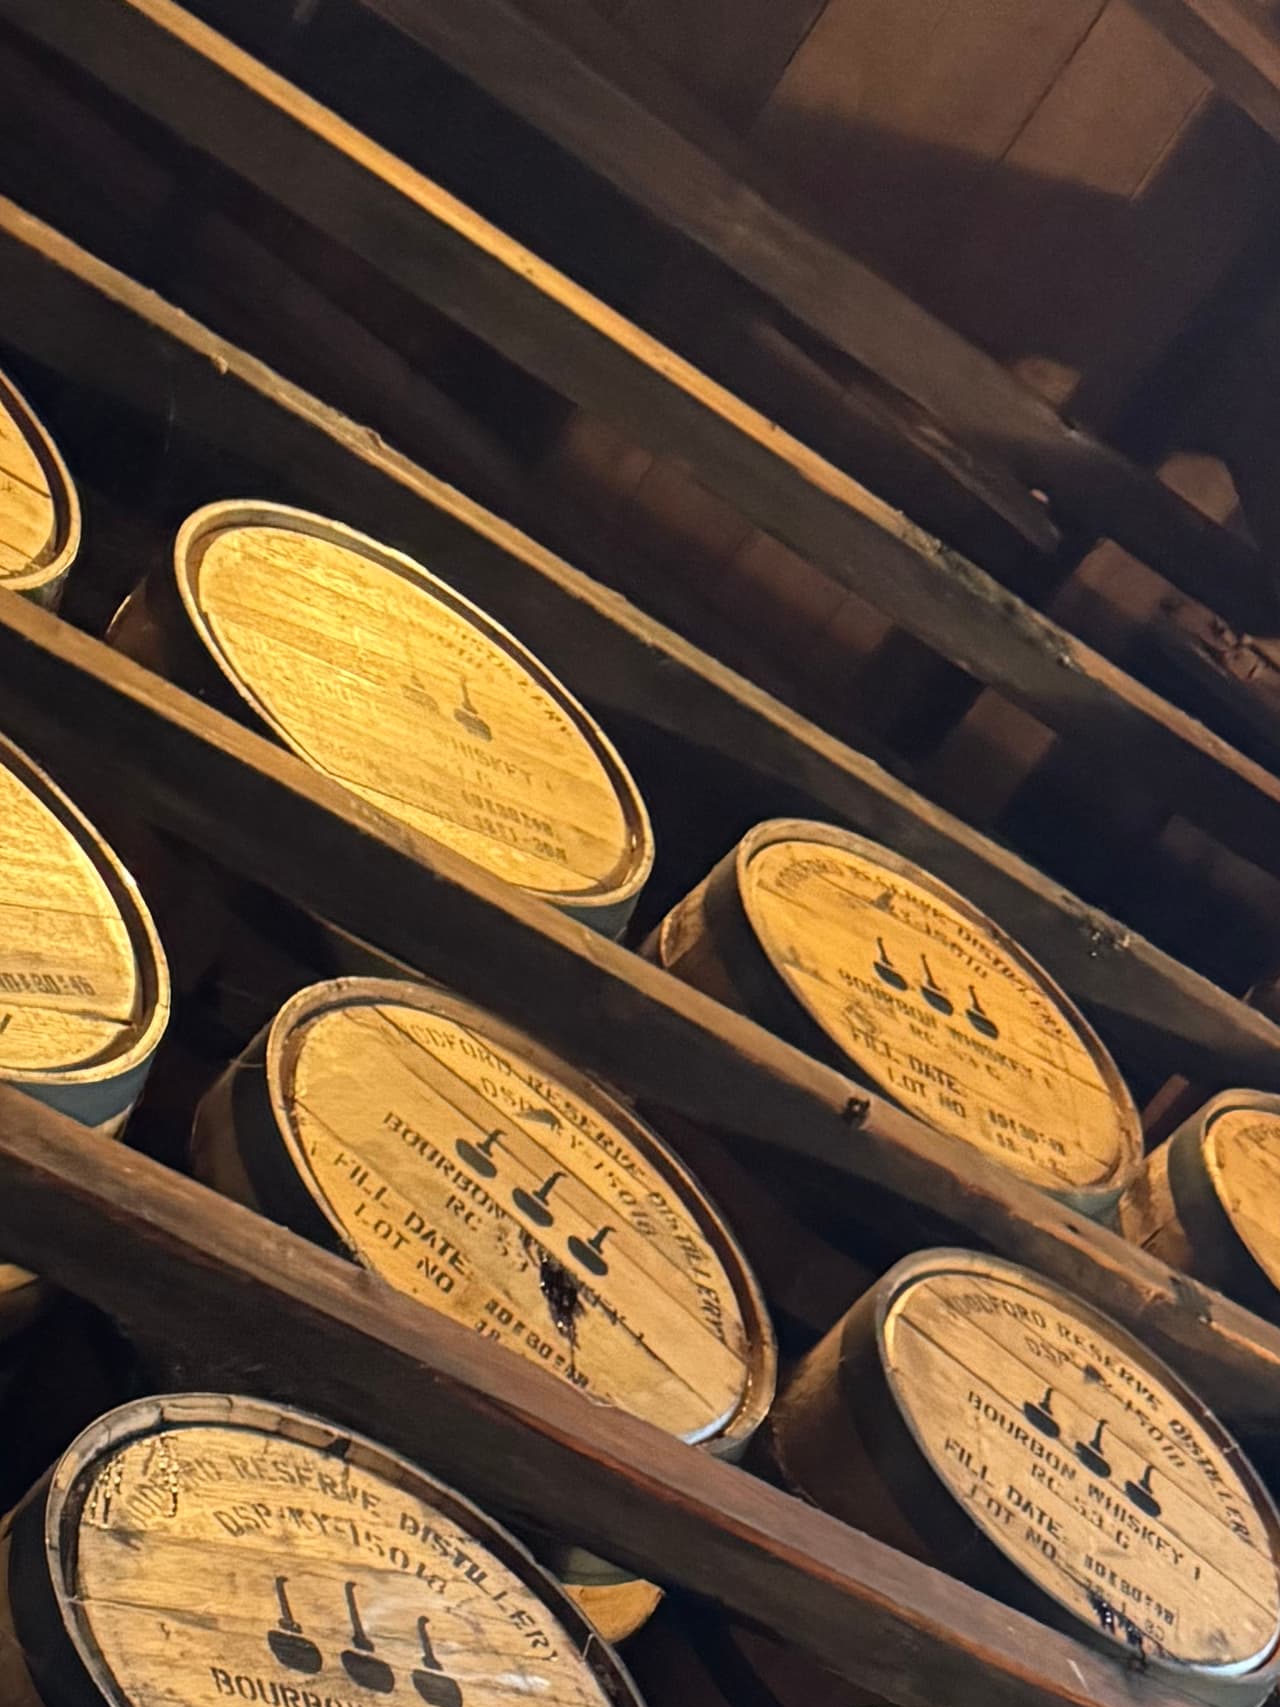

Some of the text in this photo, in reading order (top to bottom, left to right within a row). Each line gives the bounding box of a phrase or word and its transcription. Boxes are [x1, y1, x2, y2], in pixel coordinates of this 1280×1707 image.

[383, 1112, 509, 1220] BOURBON
[354, 1203, 410, 1251] LOT
[944, 1437, 994, 1487] FILL
[968, 1391, 1077, 1481] BOURBON
[1088, 1483, 1185, 1566] WHISKEY
[971, 1484, 1015, 1526] LOT
[228, 1454, 559, 1663] RESERVE DISTILLERY
